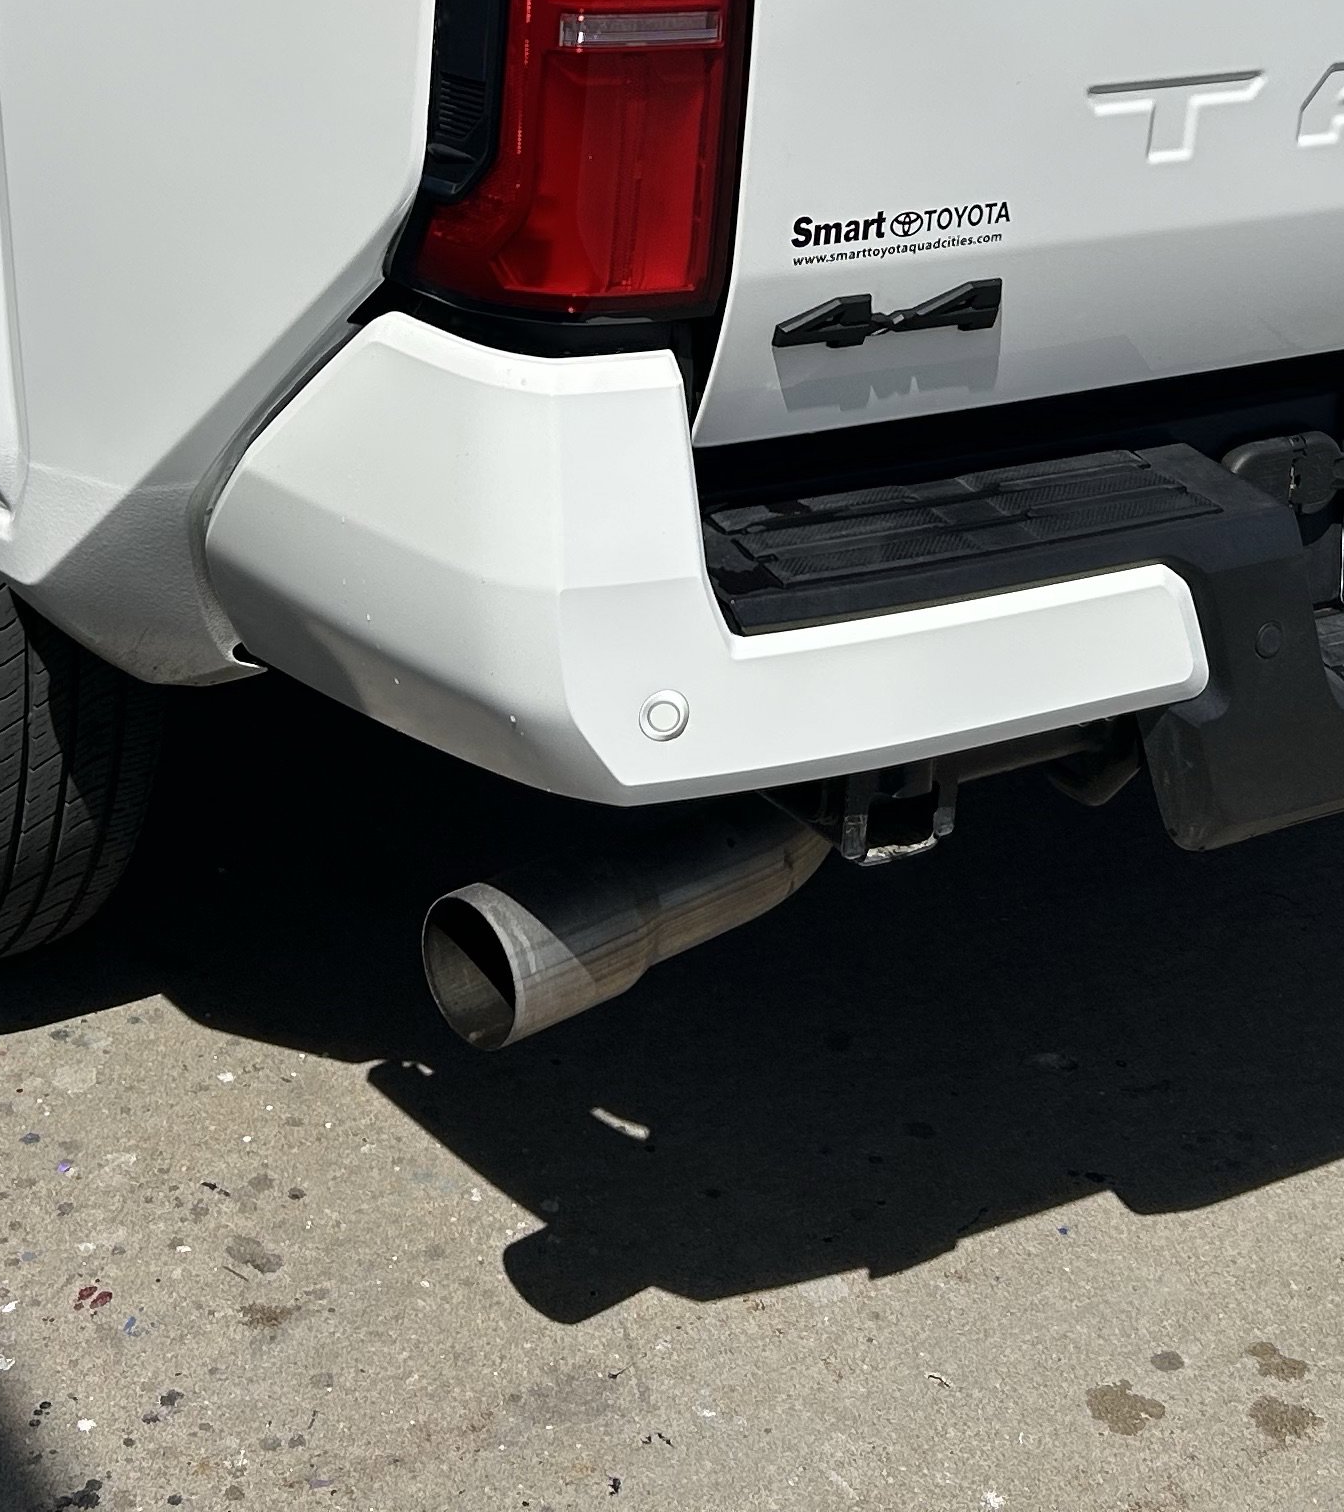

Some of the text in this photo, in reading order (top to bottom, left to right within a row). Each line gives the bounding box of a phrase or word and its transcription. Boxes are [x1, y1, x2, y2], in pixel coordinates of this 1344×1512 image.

[791, 201, 1011, 249] Smart TOYOTA
[792, 232, 1003, 267] www.smarttoyotaquadcities.com
